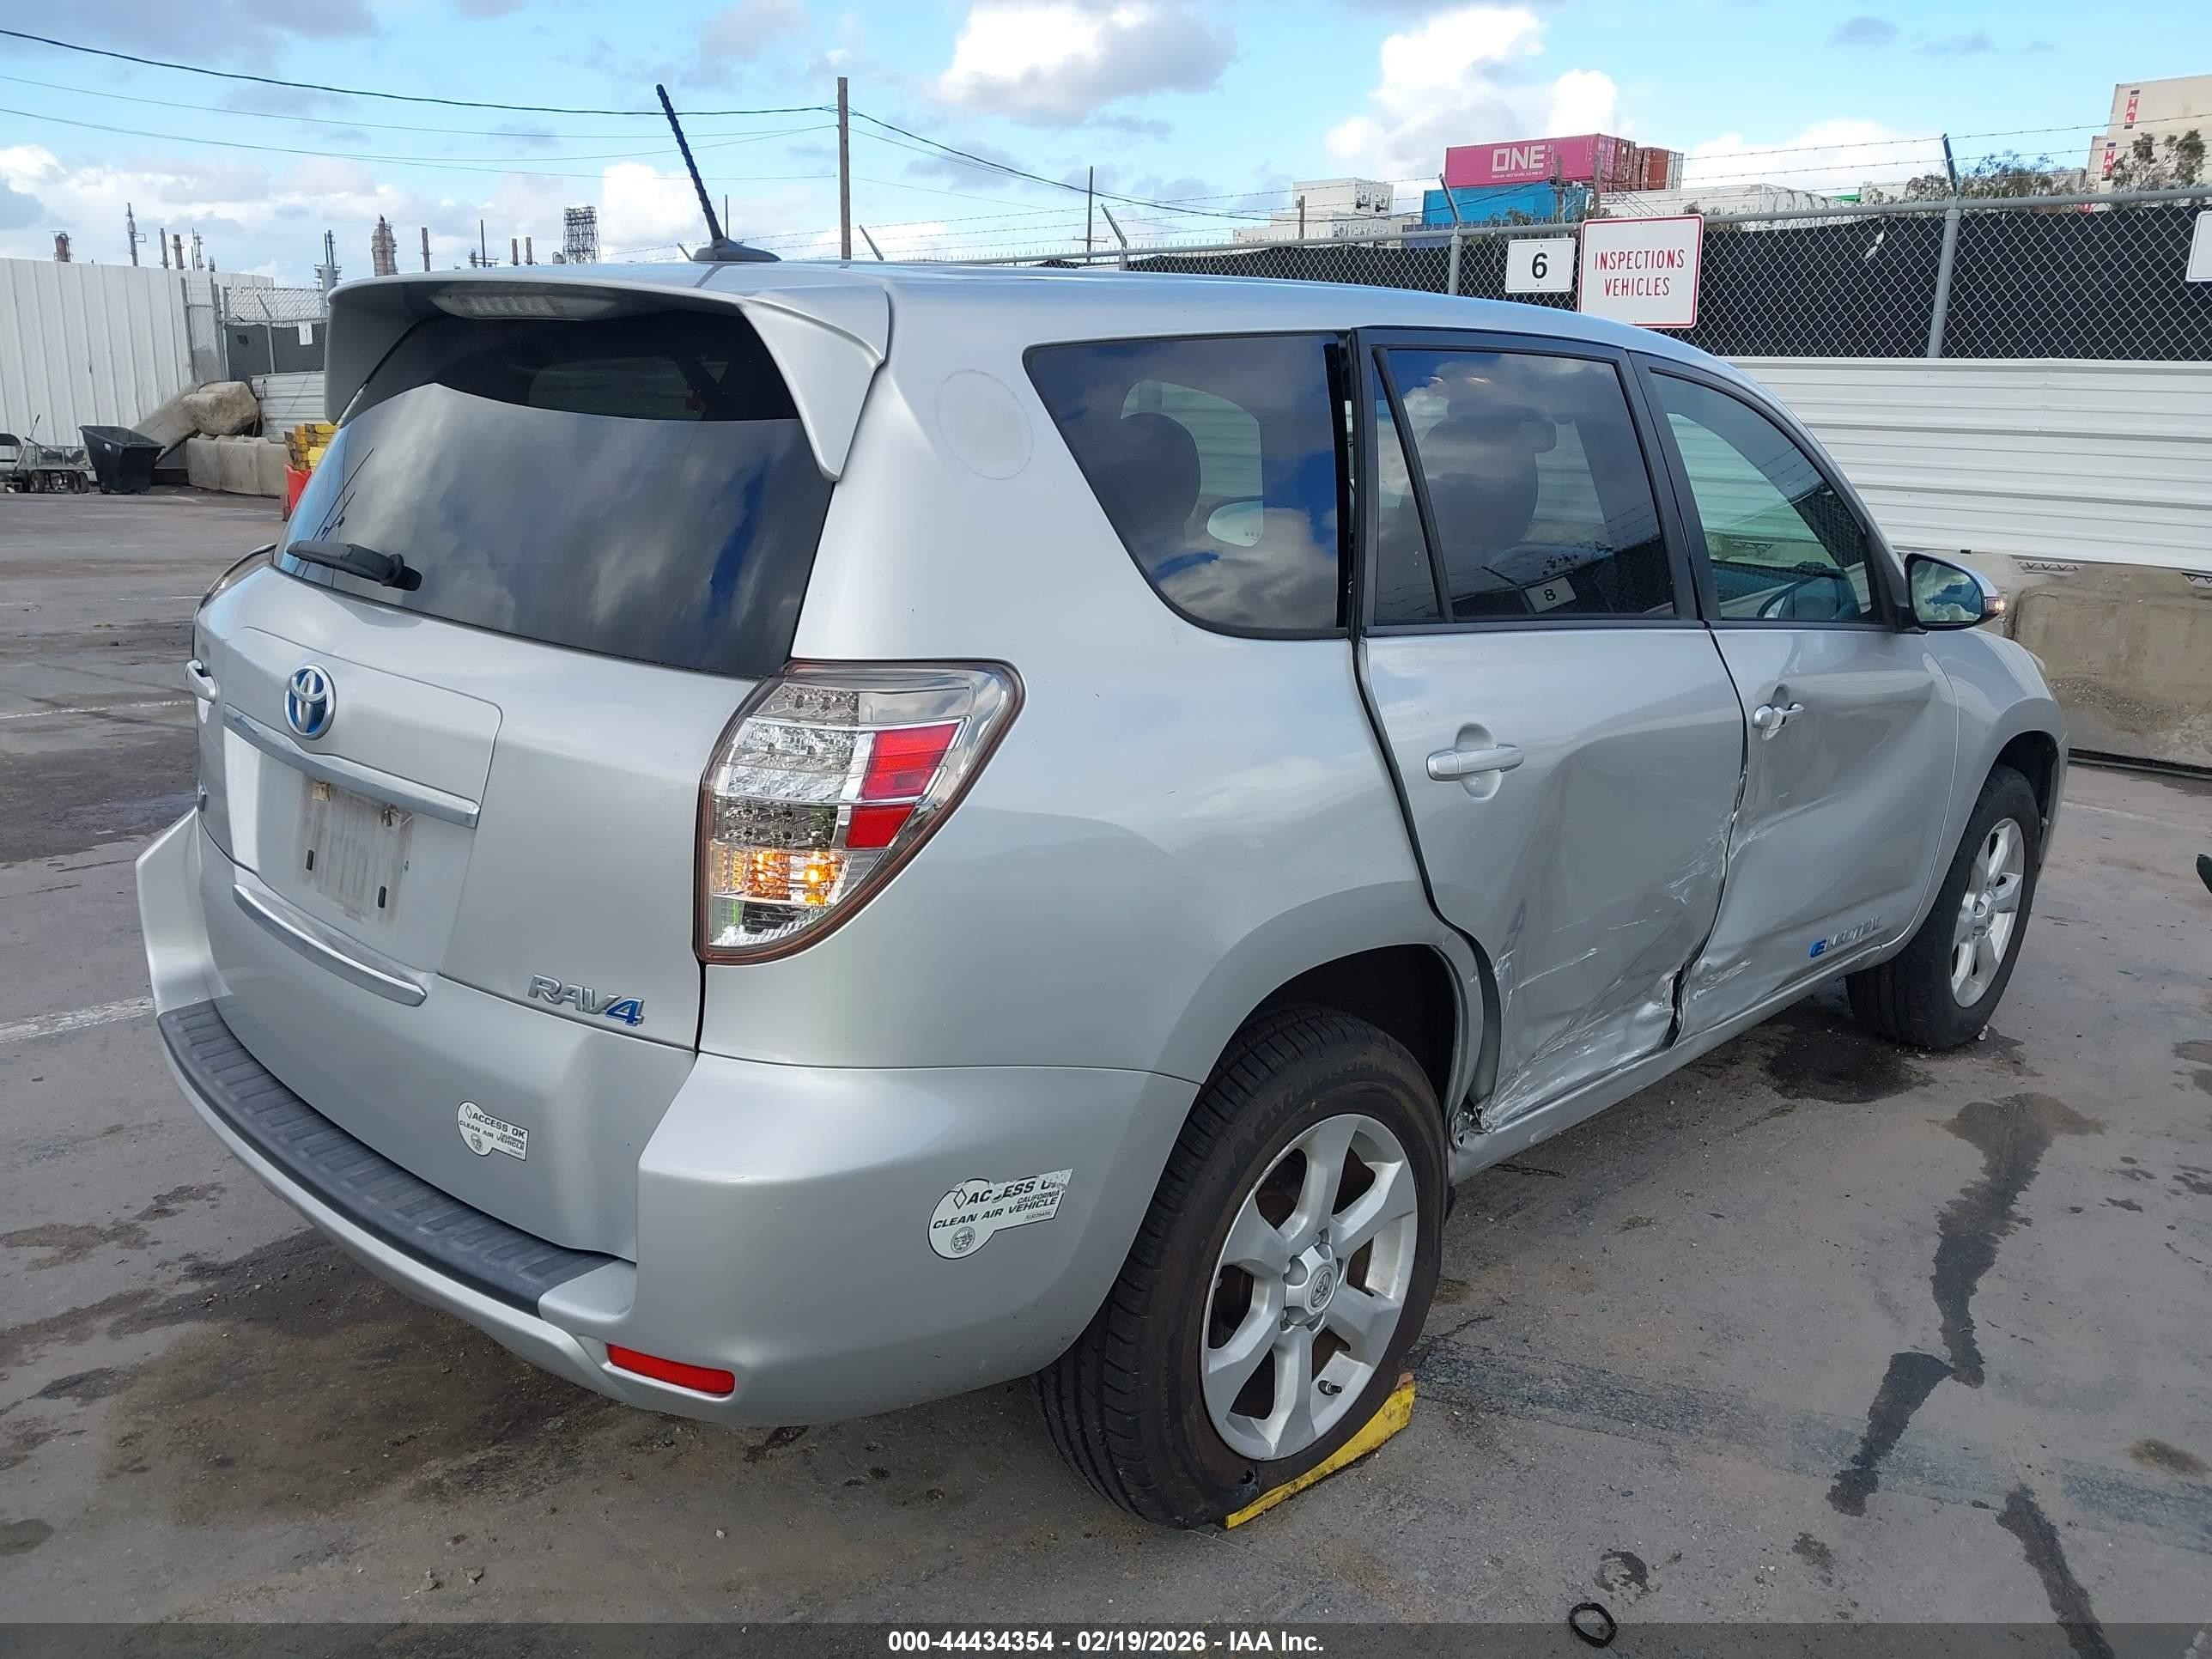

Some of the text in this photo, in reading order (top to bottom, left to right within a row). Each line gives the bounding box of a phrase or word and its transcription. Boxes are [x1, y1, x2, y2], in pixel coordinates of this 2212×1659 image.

[1492, 144, 1546, 172] ONE
[1531, 252, 1548, 279] 6
[1594, 248, 1686, 270] INSPECTIONS
[1604, 276, 1671, 297] VEHICLES
[527, 973, 646, 1027] RAV4
[459, 1120, 525, 1151] CLEAN AIR VEHICLE
[471, 1112, 526, 1139] ACCESS OK
[1017, 1189, 1060, 1205] CALIFORNIA
[933, 1196, 1059, 1230] CLEAN AIR VEHICLE
